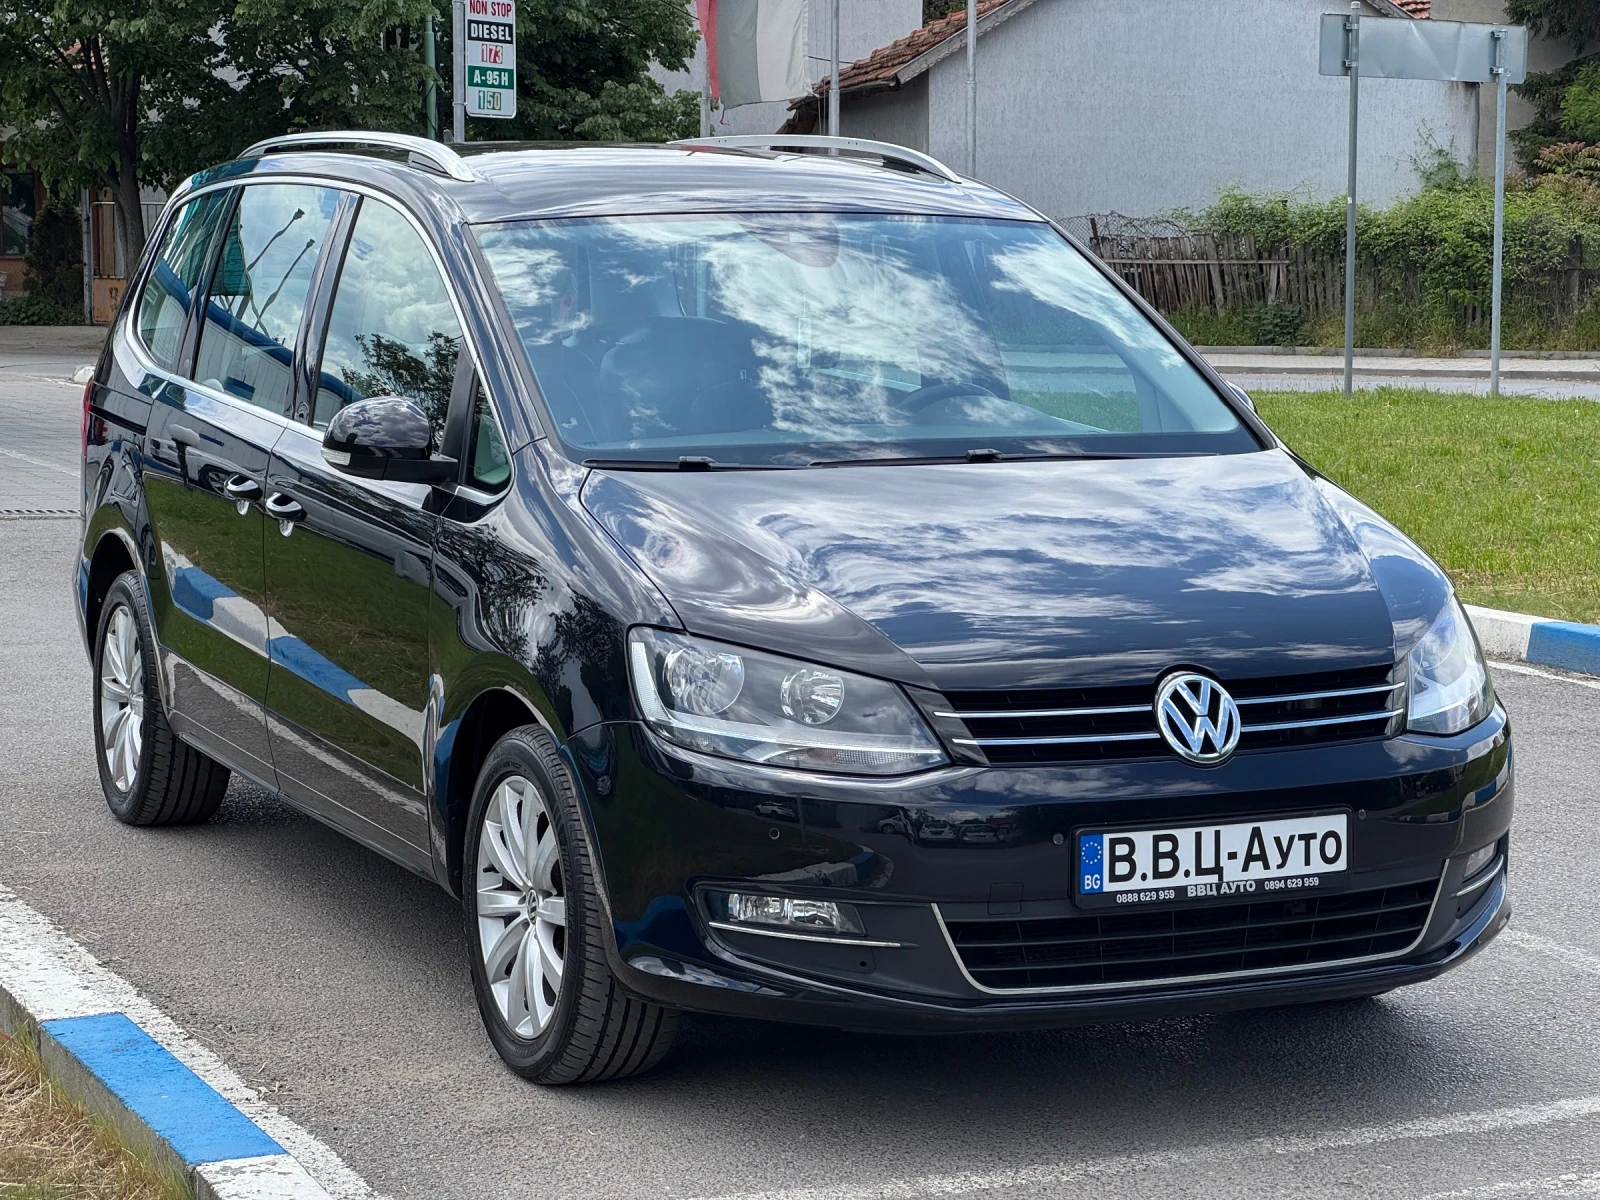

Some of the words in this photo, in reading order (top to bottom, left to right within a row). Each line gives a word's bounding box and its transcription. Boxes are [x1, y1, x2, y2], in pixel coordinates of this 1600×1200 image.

[470, 0, 487, 15] NON
[491, 1, 512, 17] STOP
[470, 23, 511, 41] DIESEL
[1108, 826, 1342, 883] В.В.Ц-Ауто
[1084, 874, 1100, 890] BG
[1116, 893, 1139, 903] 0888
[1140, 892, 1157, 901] 629
[1159, 889, 1175, 900] 959
[1187, 883, 1217, 897] ВВЦ
[1220, 881, 1256, 894] АУТО
[1264, 879, 1286, 890] 0894
[1287, 878, 1302, 888] 629
[1304, 877, 1319, 887] 959
